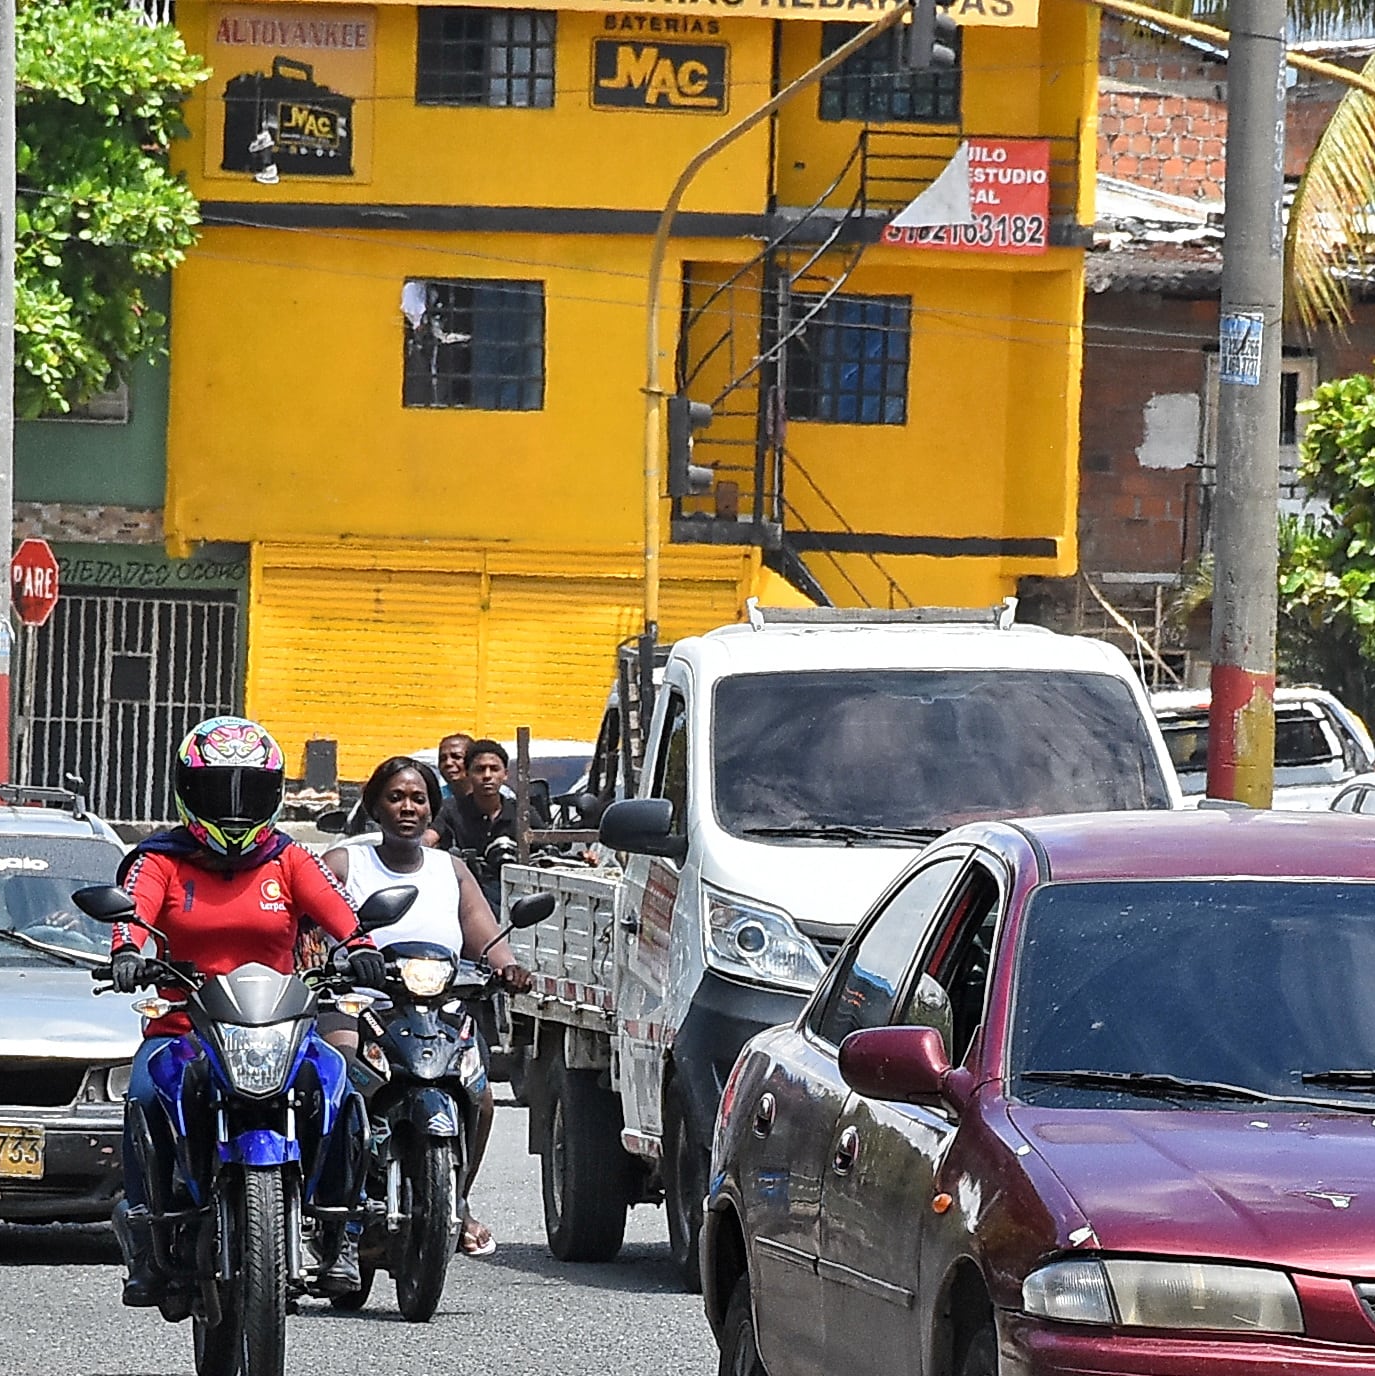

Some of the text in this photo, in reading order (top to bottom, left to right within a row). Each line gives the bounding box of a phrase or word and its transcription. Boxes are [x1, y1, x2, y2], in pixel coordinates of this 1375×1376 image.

[599, 46, 718, 107] MAC
[283, 107, 333, 138] MAC
[14, 564, 53, 599] PARE
